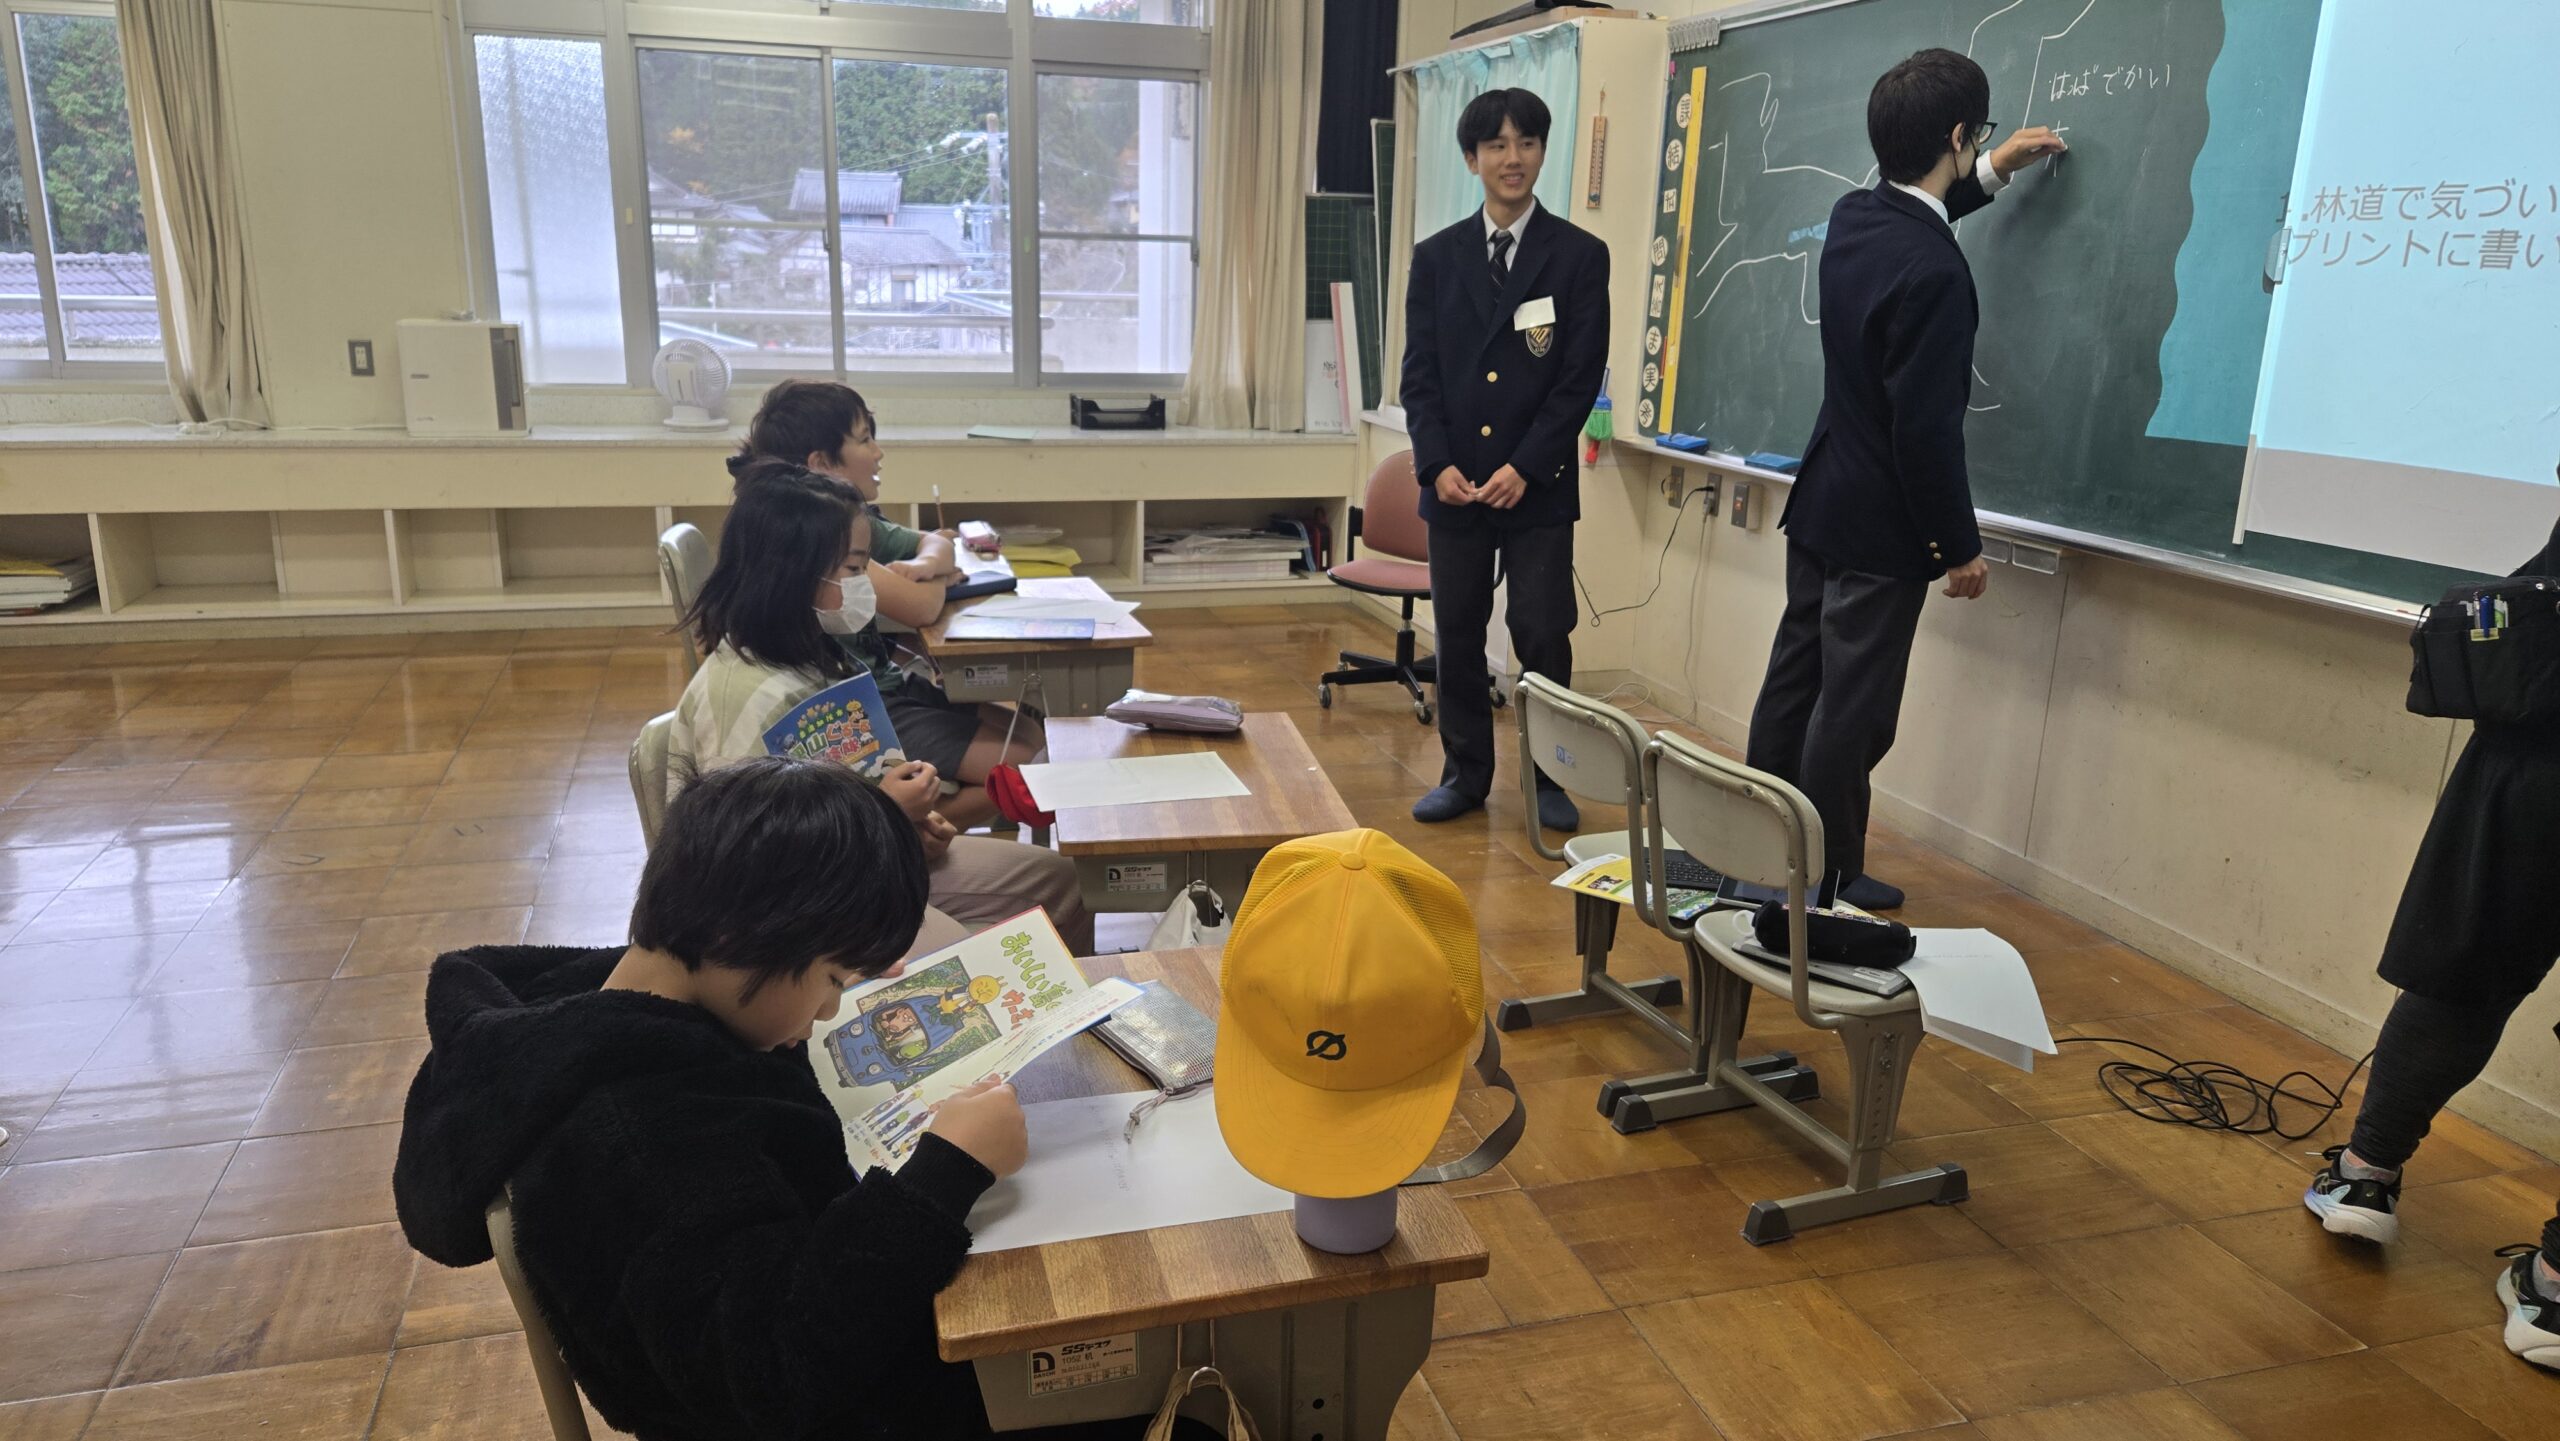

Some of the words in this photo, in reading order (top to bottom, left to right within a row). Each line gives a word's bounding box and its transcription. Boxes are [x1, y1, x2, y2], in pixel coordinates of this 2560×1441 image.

[2286, 227, 2560, 271] プリントに書い
